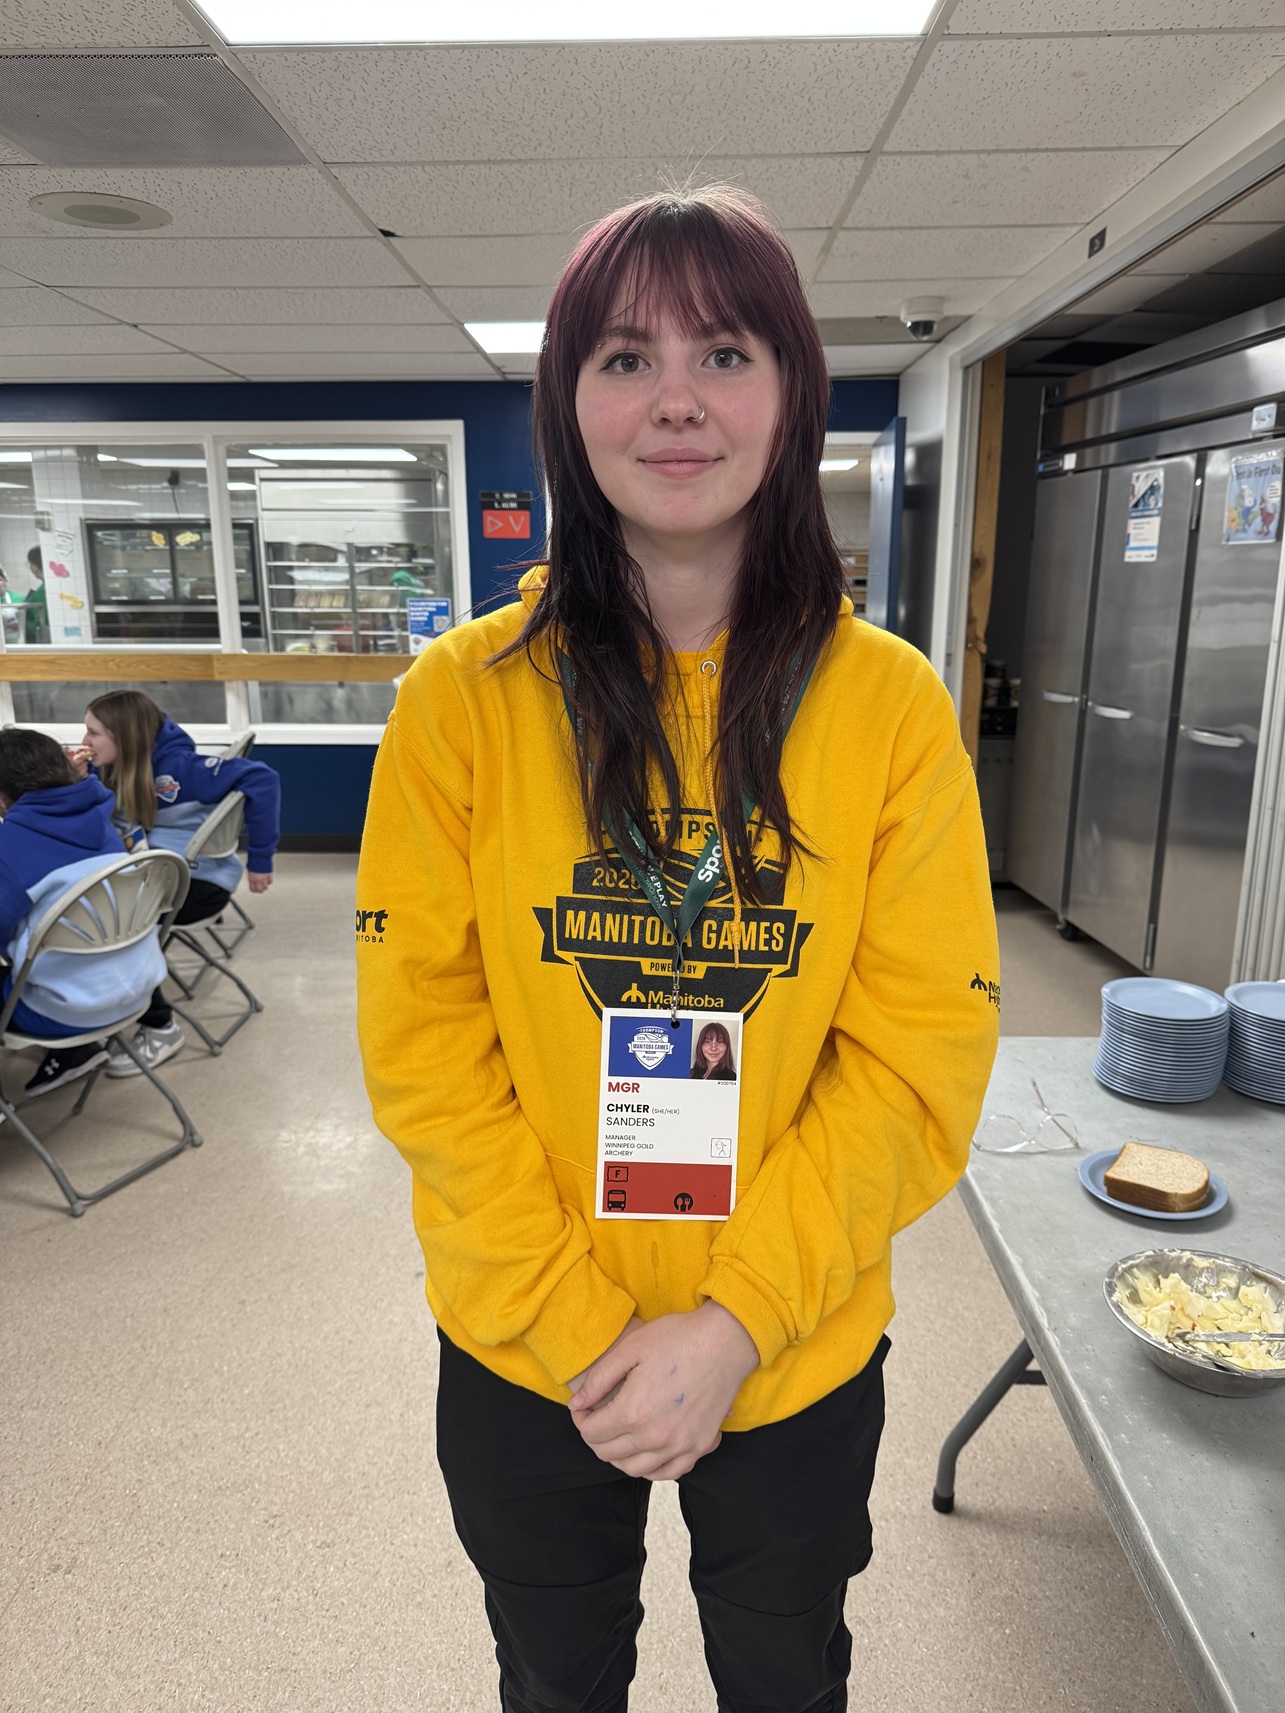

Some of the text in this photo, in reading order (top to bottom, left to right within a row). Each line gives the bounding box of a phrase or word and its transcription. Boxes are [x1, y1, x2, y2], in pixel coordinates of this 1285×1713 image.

[653, 881, 668, 908] PLAY
[702, 919, 785, 952] GAMES
[649, 961, 698, 975] POWE BY
[648, 989, 725, 1009] Manitoba
[607, 1081, 641, 1094] MGR
[606, 1103, 650, 1114] CHYLER
[606, 1116, 656, 1127] SANDERS
[615, 1169, 621, 1179] F
